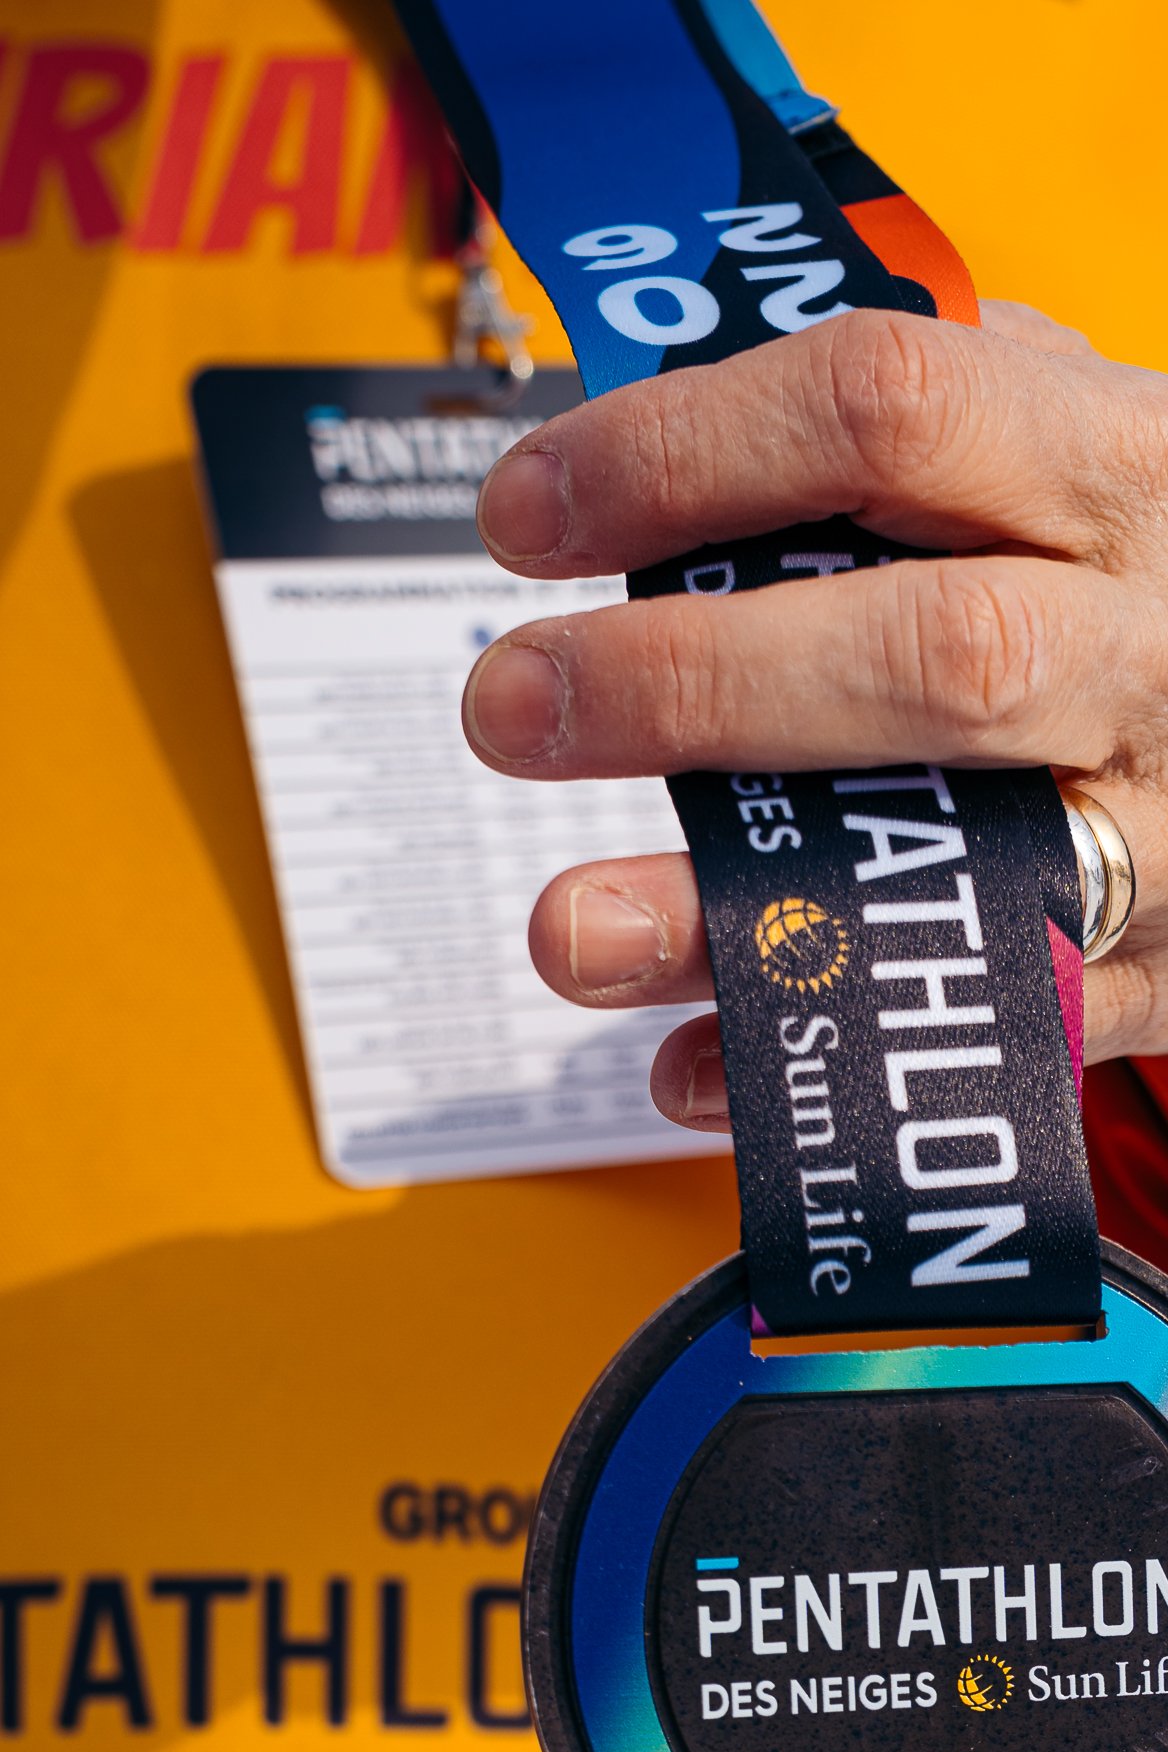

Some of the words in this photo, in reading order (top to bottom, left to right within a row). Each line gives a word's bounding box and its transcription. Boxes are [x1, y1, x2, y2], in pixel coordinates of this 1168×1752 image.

[730, 773, 802, 853] GES
[780, 1014, 840, 1148] Sun
[833, 764, 1031, 1288] TATHLON
[801, 1165, 872, 1297] Life
[379, 1481, 545, 1546] GRO
[0, 1573, 537, 1736] TATHLO
[701, 1680, 779, 1720] DES
[790, 1671, 938, 1714] NEIGES
[1027, 1665, 1109, 1702] Sun
